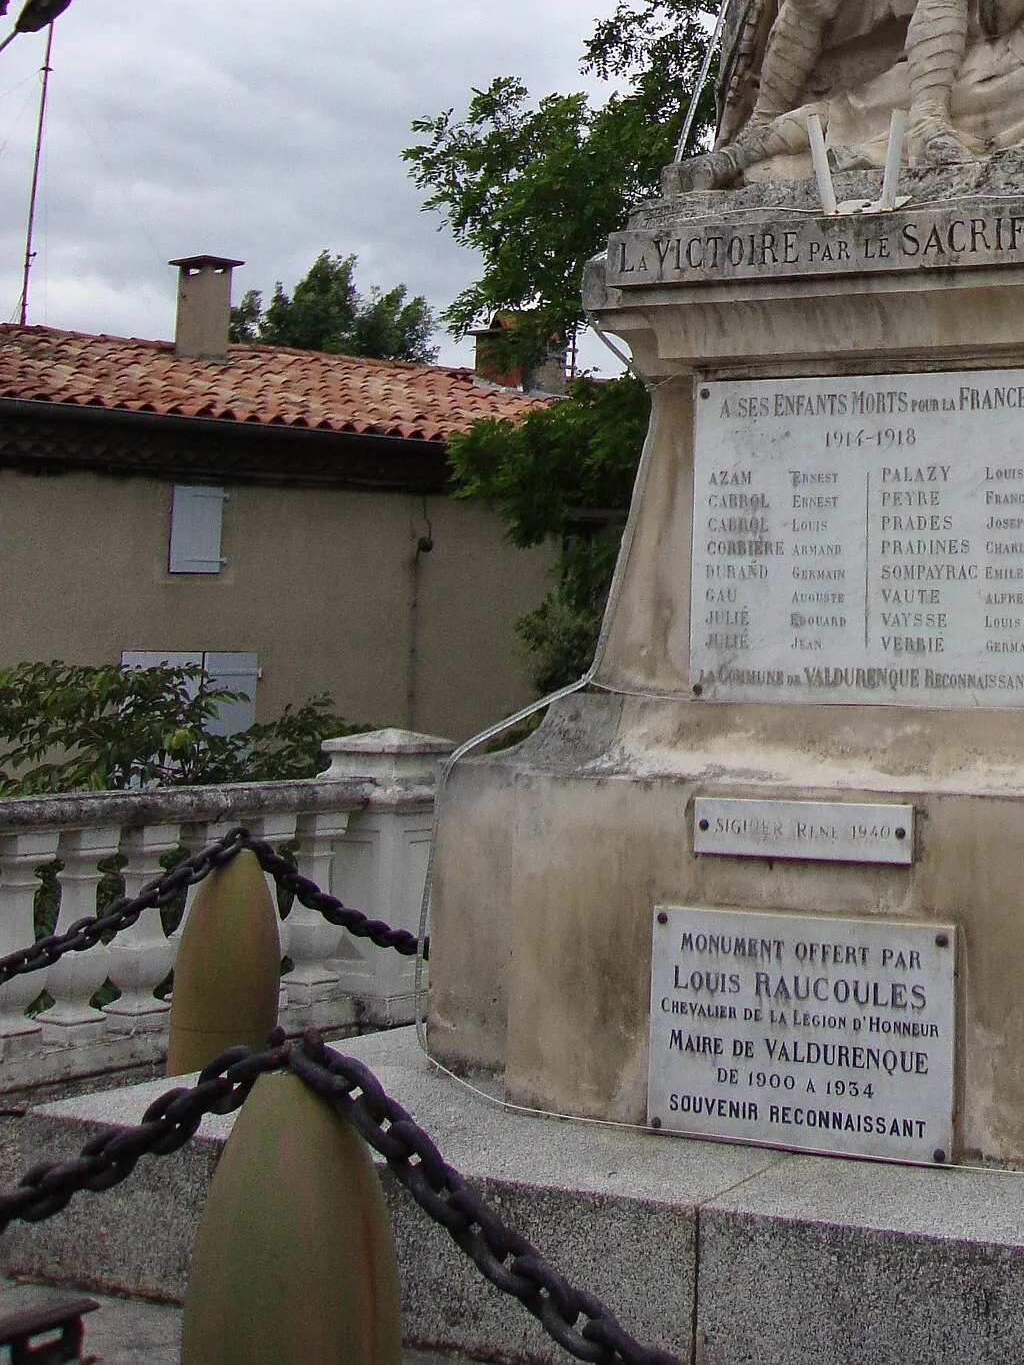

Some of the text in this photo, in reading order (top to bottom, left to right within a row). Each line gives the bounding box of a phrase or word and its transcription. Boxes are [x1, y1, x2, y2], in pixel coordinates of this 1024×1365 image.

[619, 242, 649, 273] LA
[654, 232, 799, 271] VICTOIRE
[808, 240, 850, 263] PAR
[865, 237, 891, 259] LE
[719, 399, 732, 419] A
[738, 396, 769, 418] SES
[774, 393, 848, 416] ENFANTS
[852, 390, 908, 414] MORTS
[911, 398, 939, 412] POUR
[942, 397, 956, 411] LA
[824, 428, 917, 448] 1914-1918
[708, 471, 839, 485] AZAM ERNEST
[881, 466, 1024, 482] PALAZY LOUIS
[708, 494, 839, 509] CABROL ERNEST
[881, 491, 940, 506] PEYRE
[707, 517, 828, 532] CABROL LOUIS
[881, 515, 953, 530] PRADES
[792, 544, 842, 556] ARMAND
[881, 539, 970, 555] PRADINES
[705, 565, 846, 580] DURAND GERMAIN
[881, 564, 1024, 580] SOMPAYRAC EMILE
[705, 588, 845, 604] GAU AUGUSTE
[881, 589, 940, 604] VAUTE
[881, 612, 1021, 628] VAYSSE LOUIS
[791, 637, 822, 650] JEAN
[700, 670, 716, 683] LA
[718, 665, 784, 685] COMMUNE
[787, 675, 801, 684] DE
[803, 667, 920, 690] VALDURENQUE
[851, 825, 891, 840] 1940
[681, 933, 921, 969] MONUMENT OFFERT PAR
[673, 965, 927, 1009] LOUIS RAUCOULES
[661, 997, 737, 1019] CHEVALIER
[743, 1007, 761, 1022] DE
[770, 1010, 787, 1025] LA
[853, 1015, 939, 1038] D'HONNEUR
[669, 1029, 929, 1076] MAIRE DE VALDURENQUE
[717, 1068, 874, 1098] DE 1900 A 1934
[669, 1093, 927, 1139] SOUVENIR RECONNAISSANT
